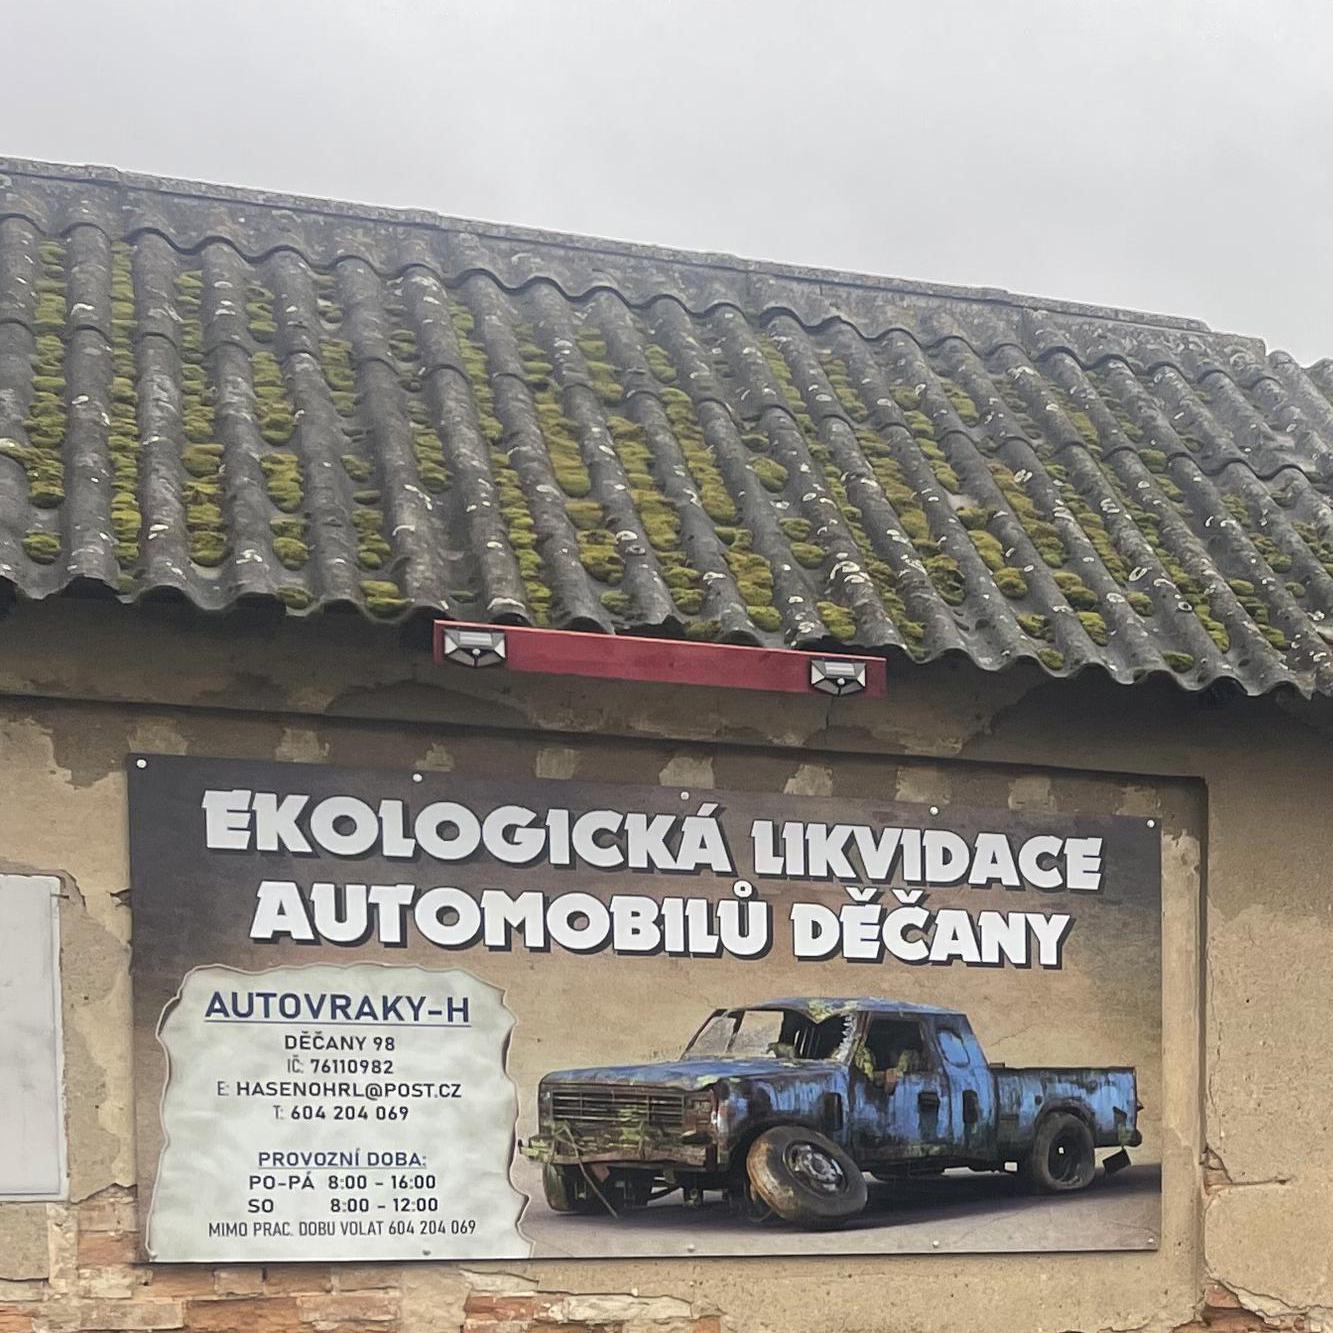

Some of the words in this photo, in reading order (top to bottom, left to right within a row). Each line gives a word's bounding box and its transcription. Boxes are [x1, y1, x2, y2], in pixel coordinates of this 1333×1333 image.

[202, 789, 733, 874] EKOLOGICKÁ
[751, 819, 1103, 891] LIKVIDACE
[249, 880, 768, 957] AUTOMOBILŮ
[790, 887, 1071, 966] DĚČANY
[205, 991, 470, 1023] AUTOVRAKY-H
[284, 1031, 367, 1050] DĚČANY
[373, 1036, 395, 1051] 98
[310, 1059, 394, 1074] 76110982
[237, 1082, 462, 1099] HASENOHRL@POST.CZ
[291, 1106, 326, 1120] 604
[333, 1106, 368, 1120] 204
[376, 1106, 409, 1120] 069
[258, 1148, 360, 1167] PROVOZNÍ
[368, 1153, 426, 1167] DOBA:
[249, 1171, 315, 1190] PO-PÁ
[328, 1176, 367, 1189] 8:00
[391, 1175, 436, 1189] 16:00
[248, 1199, 274, 1213] SO
[331, 1198, 369, 1212] 8:00
[393, 1198, 438, 1212] 12:00
[208, 1223, 248, 1237] MIMO
[253, 1222, 293, 1237] PRAC.
[300, 1222, 336, 1236] DOBU
[341, 1221, 384, 1235] VOLAT
[389, 1221, 415, 1234] 604
[420, 1221, 446, 1234] 204
[451, 1220, 476, 1234] 069
